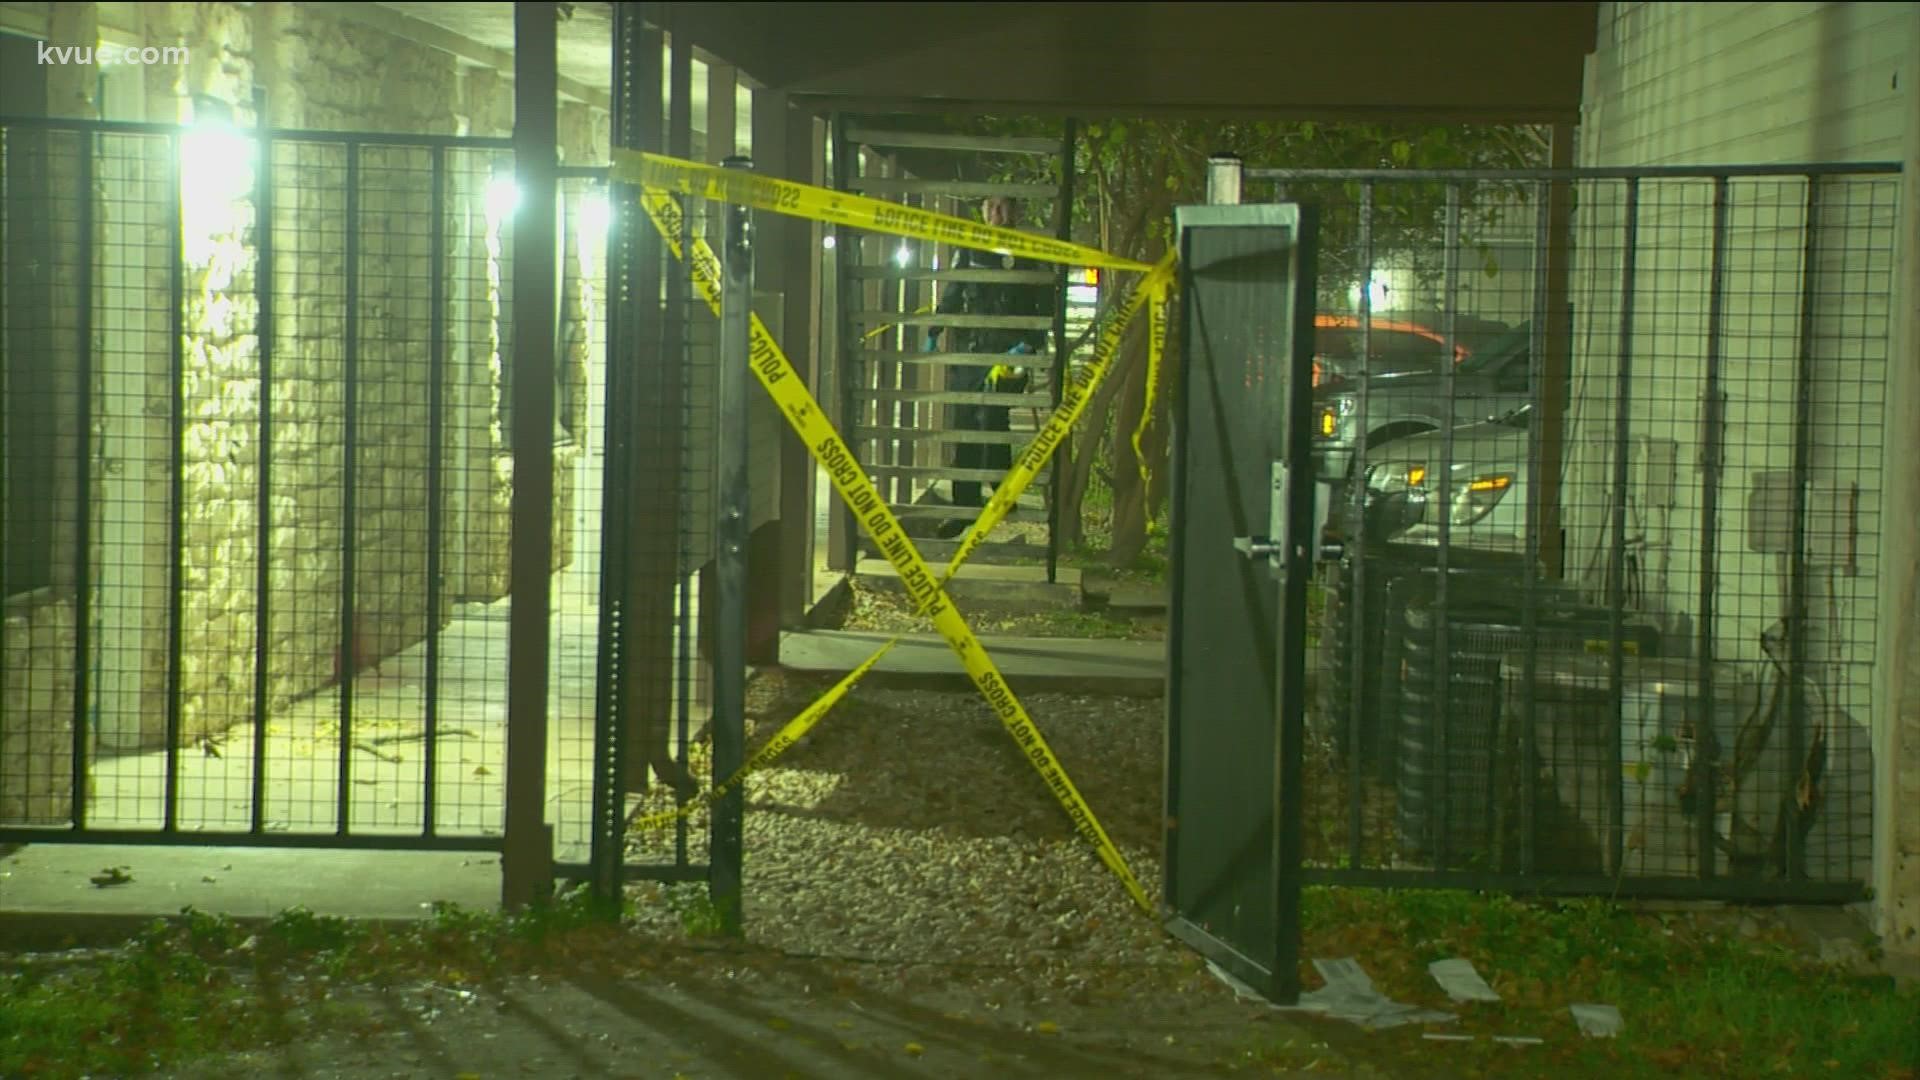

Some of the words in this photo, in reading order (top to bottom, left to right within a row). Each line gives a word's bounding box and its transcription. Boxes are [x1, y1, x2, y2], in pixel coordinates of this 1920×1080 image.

[1024, 419, 1066, 472] POLICE
[1056, 389, 1084, 423] LINE
[816, 437, 858, 486] CROSS
[847, 482, 881, 517] NOT
[868, 511, 893, 537] DO
[882, 534, 914, 574] LINE
[978, 671, 1018, 719] CROSS
[1011, 719, 1036, 748] NOT
[1030, 747, 1051, 769] DO
[1046, 767, 1073, 801] LINE
[1067, 801, 1105, 847] POLICE
